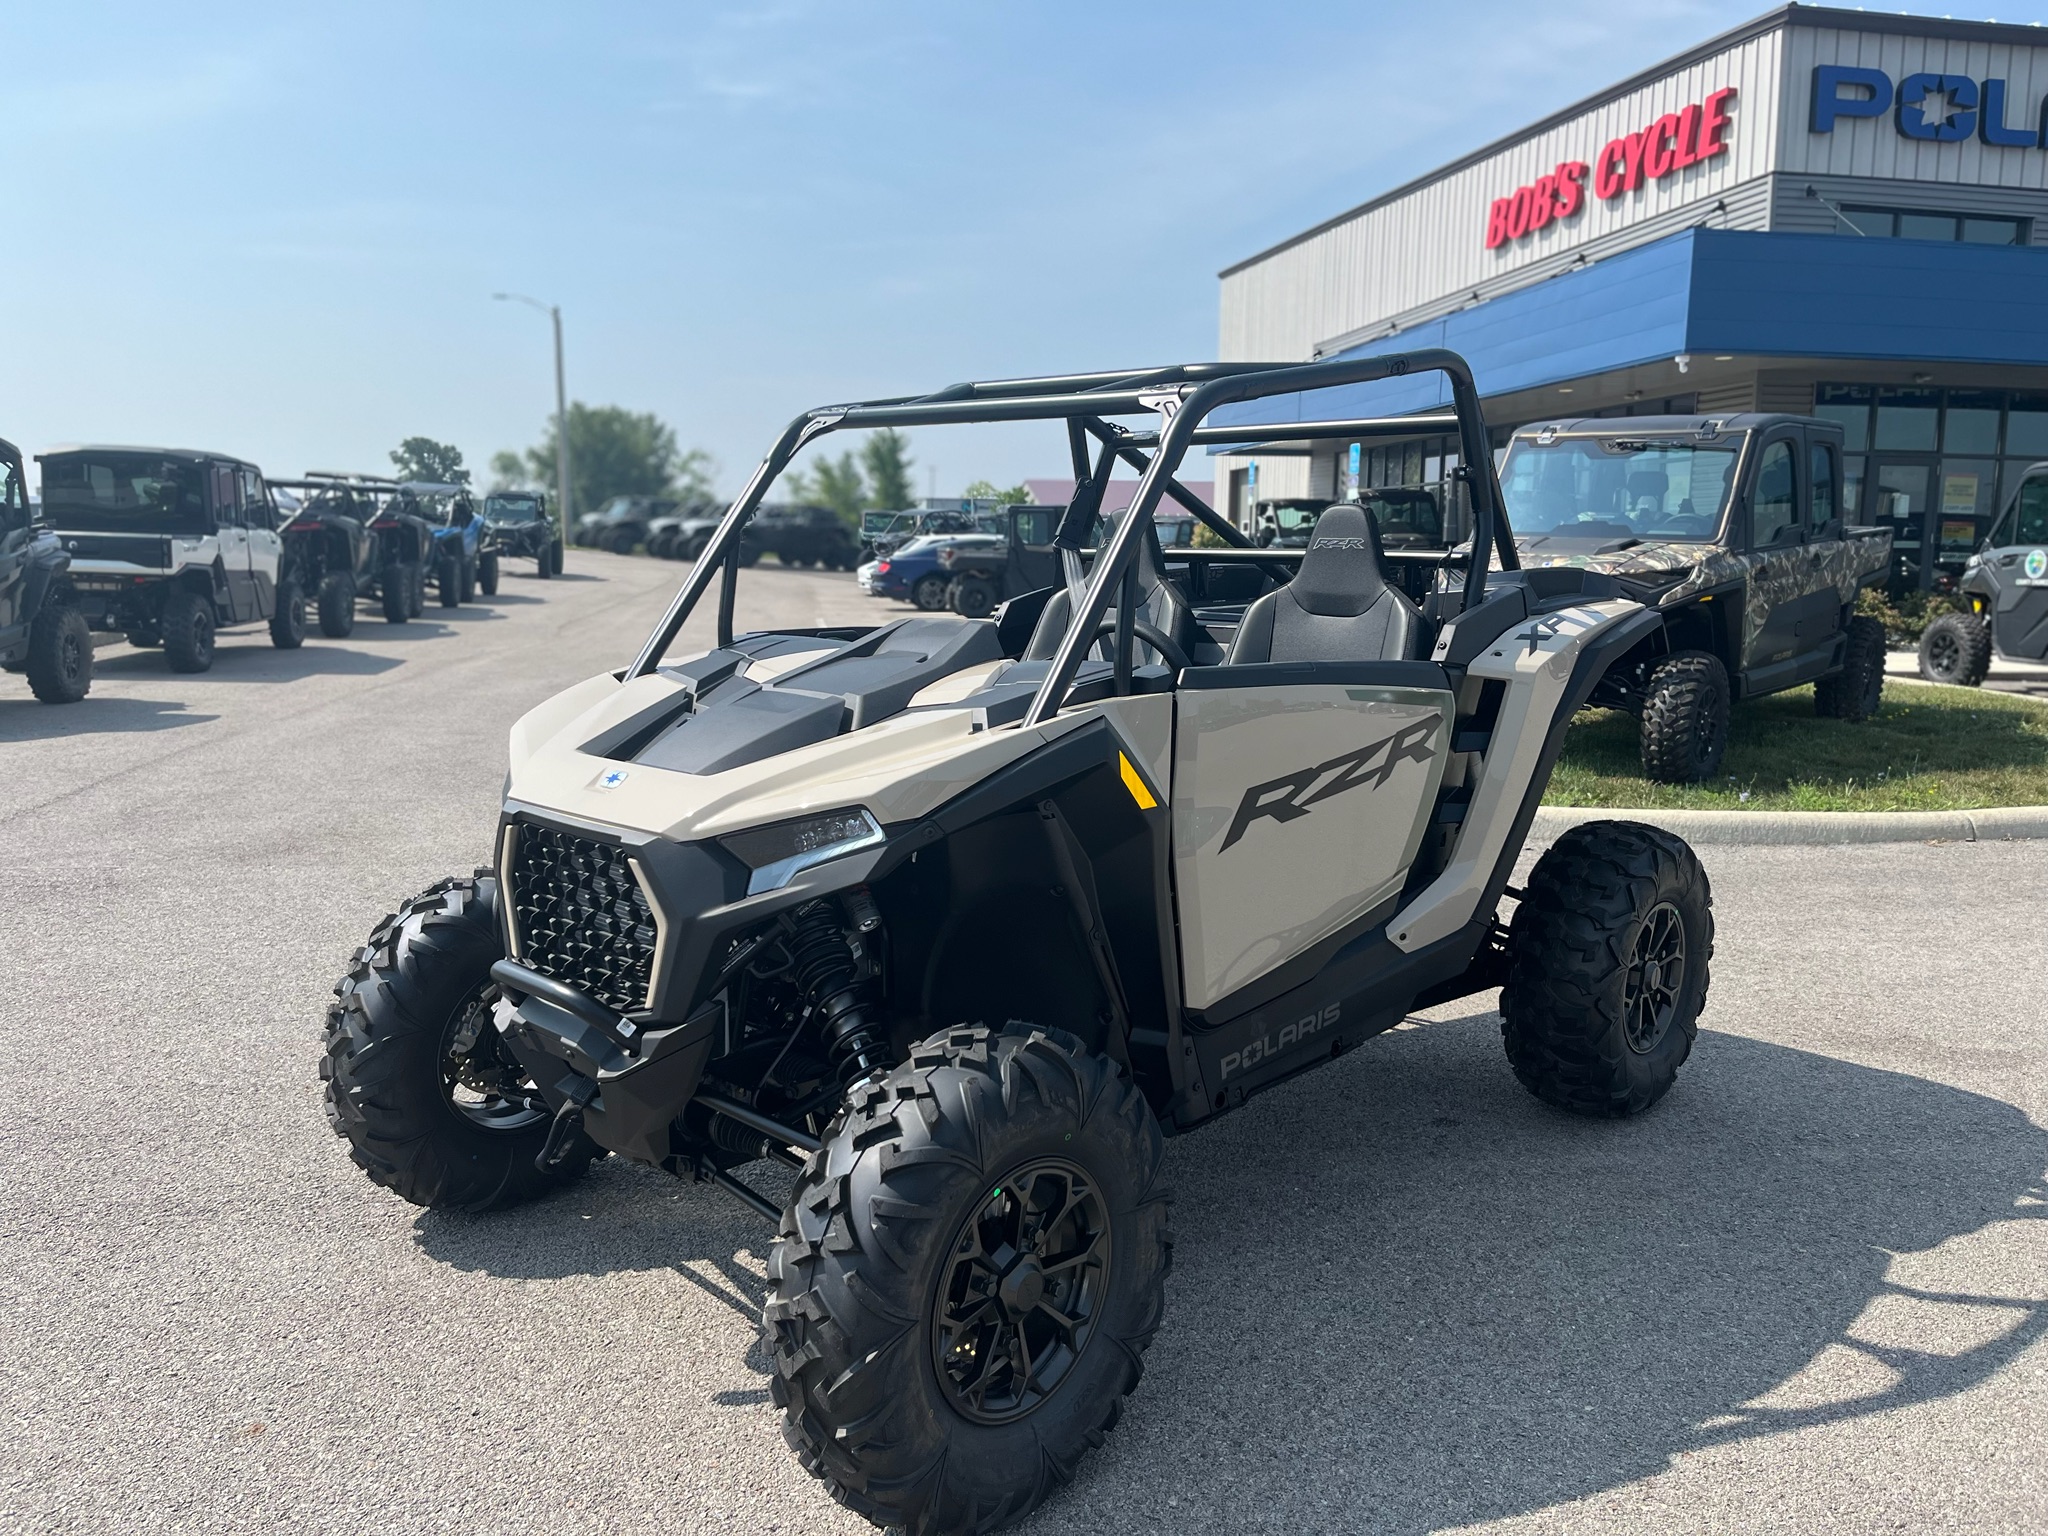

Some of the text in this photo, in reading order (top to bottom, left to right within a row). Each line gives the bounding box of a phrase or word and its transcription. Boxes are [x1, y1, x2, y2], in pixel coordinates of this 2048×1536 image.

[1809, 64, 2048, 149] POL
[1485, 87, 1738, 249] BOB'S CYCLE
[1313, 537, 1365, 550] RZR
[1514, 612, 1567, 658] XP
[1217, 713, 1444, 856] RZR
[1220, 1001, 1341, 1081] POLARIS
